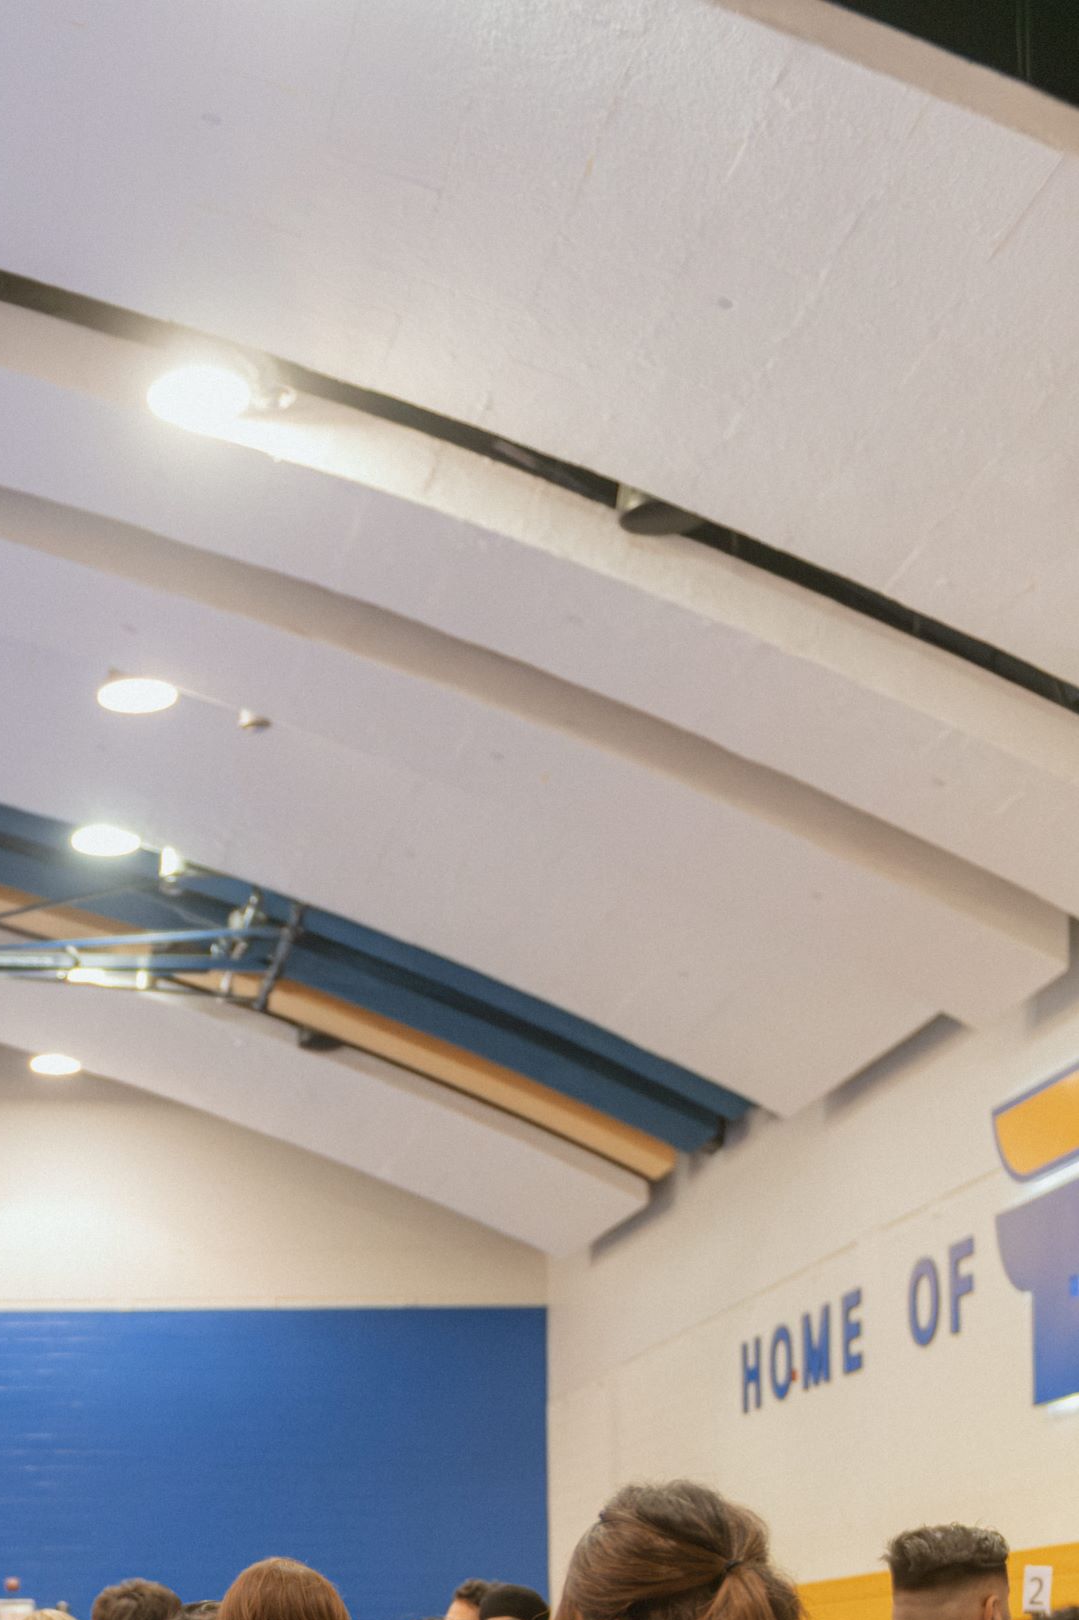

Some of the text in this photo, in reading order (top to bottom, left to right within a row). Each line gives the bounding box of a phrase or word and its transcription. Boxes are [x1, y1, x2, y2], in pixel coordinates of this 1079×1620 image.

[742, 1236, 975, 1414] HOME OF
[1029, 1576, 1044, 1605] 2
